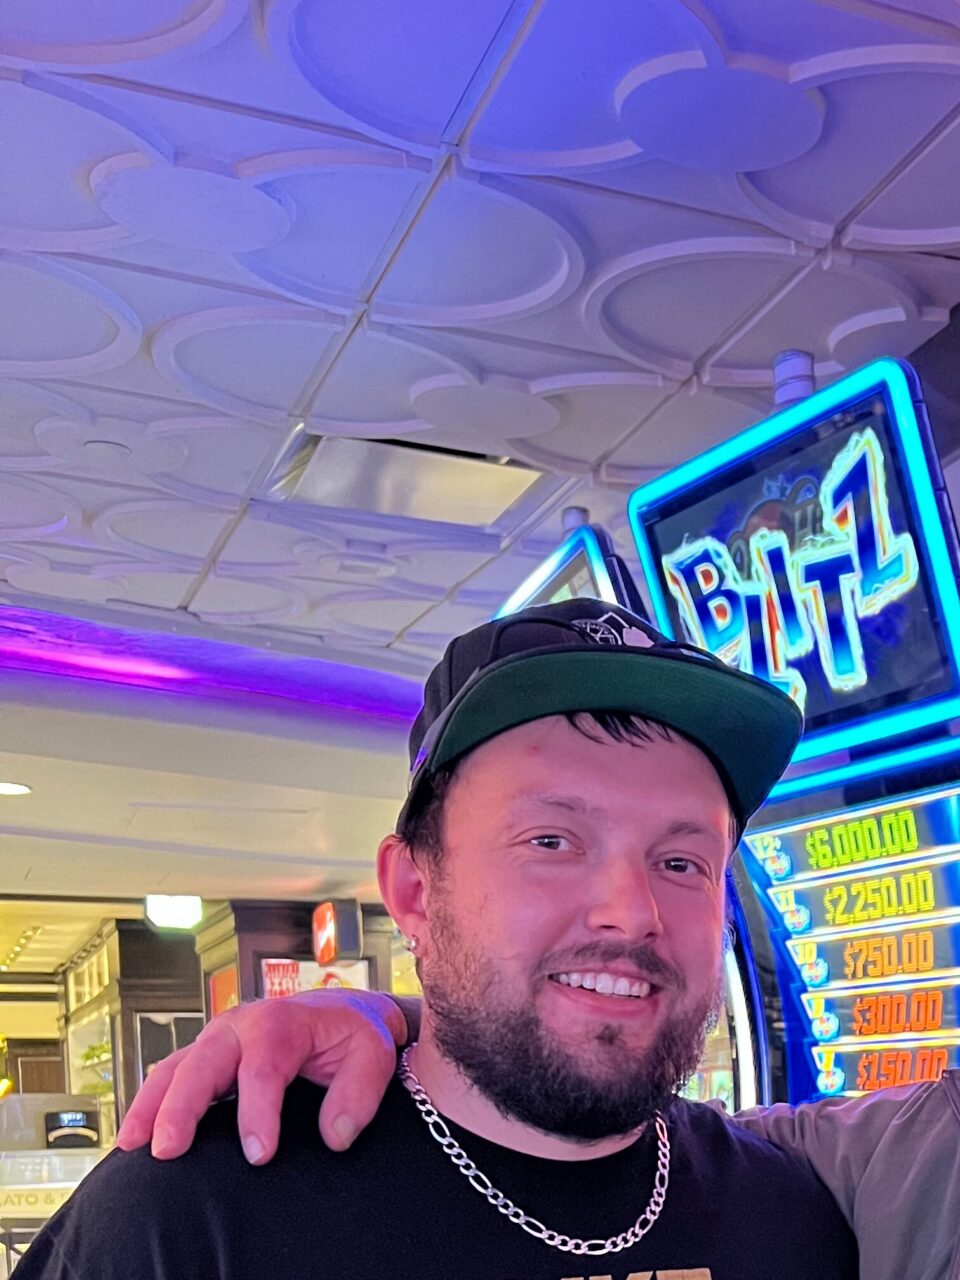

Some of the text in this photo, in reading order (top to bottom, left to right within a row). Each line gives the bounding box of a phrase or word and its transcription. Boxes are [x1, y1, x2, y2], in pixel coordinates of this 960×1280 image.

[668, 434, 913, 703] BLITZ
[823, 871, 935, 925] $2,250.00
[844, 931, 935, 979] $750.00
[852, 990, 943, 1036] $300.00
[856, 1048, 948, 1090] $150.00
[0, 1192, 39, 1206] ATO
